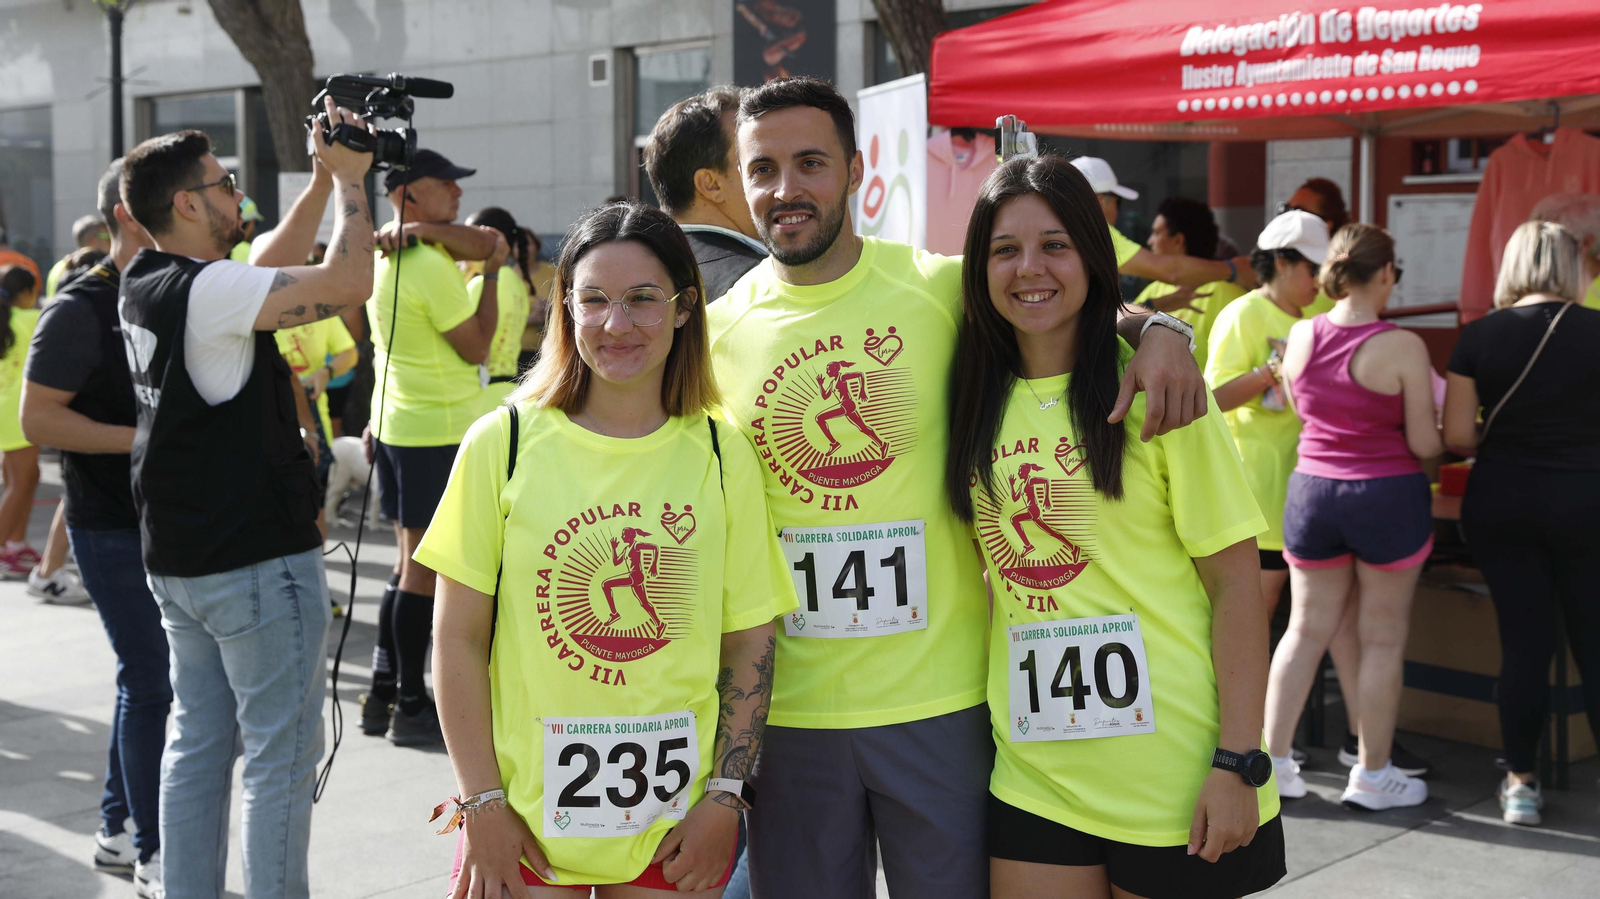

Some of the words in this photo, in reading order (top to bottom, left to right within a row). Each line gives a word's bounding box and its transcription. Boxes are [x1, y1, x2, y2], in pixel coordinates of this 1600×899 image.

[1180, 10, 1316, 56] Delegación
[1319, 8, 1353, 43] de
[1356, 3, 1483, 42] Deportes
[1181, 64, 1235, 90] Ilustre
[1235, 53, 1352, 88] Ayuntamiento
[1353, 50, 1379, 77] de
[1379, 48, 1418, 74] San
[1417, 44, 1481, 72] Roque
[754, 335, 844, 408] POPULAR
[751, 417, 814, 503] CARRERA
[808, 472, 840, 486] PUENTE
[842, 465, 882, 486] MAYORGA
[821, 494, 859, 511] VII
[543, 502, 642, 561] POPULAR
[783, 533, 794, 543] VII
[795, 532, 834, 544] CARRERA
[836, 529, 884, 542] SOLIDARIA
[886, 526, 917, 539] APRON
[793, 546, 908, 612] 141
[536, 568, 585, 671] CARRERA
[1026, 594, 1059, 612] VII
[581, 639, 612, 660] PUENTE
[615, 643, 655, 660] MAYORGA
[1012, 632, 1021, 642] VII
[1021, 628, 1051, 642] CARRERA
[1053, 623, 1099, 638] SOLIDARIA
[1102, 621, 1133, 634] APRON
[589, 664, 626, 686] VII
[1019, 642, 1139, 713] 140
[551, 723, 564, 735] VII
[566, 723, 612, 735] CARRERA
[614, 720, 662, 734] SOLIDARIA
[664, 716, 690, 731] APRON
[557, 736, 691, 808] 235
